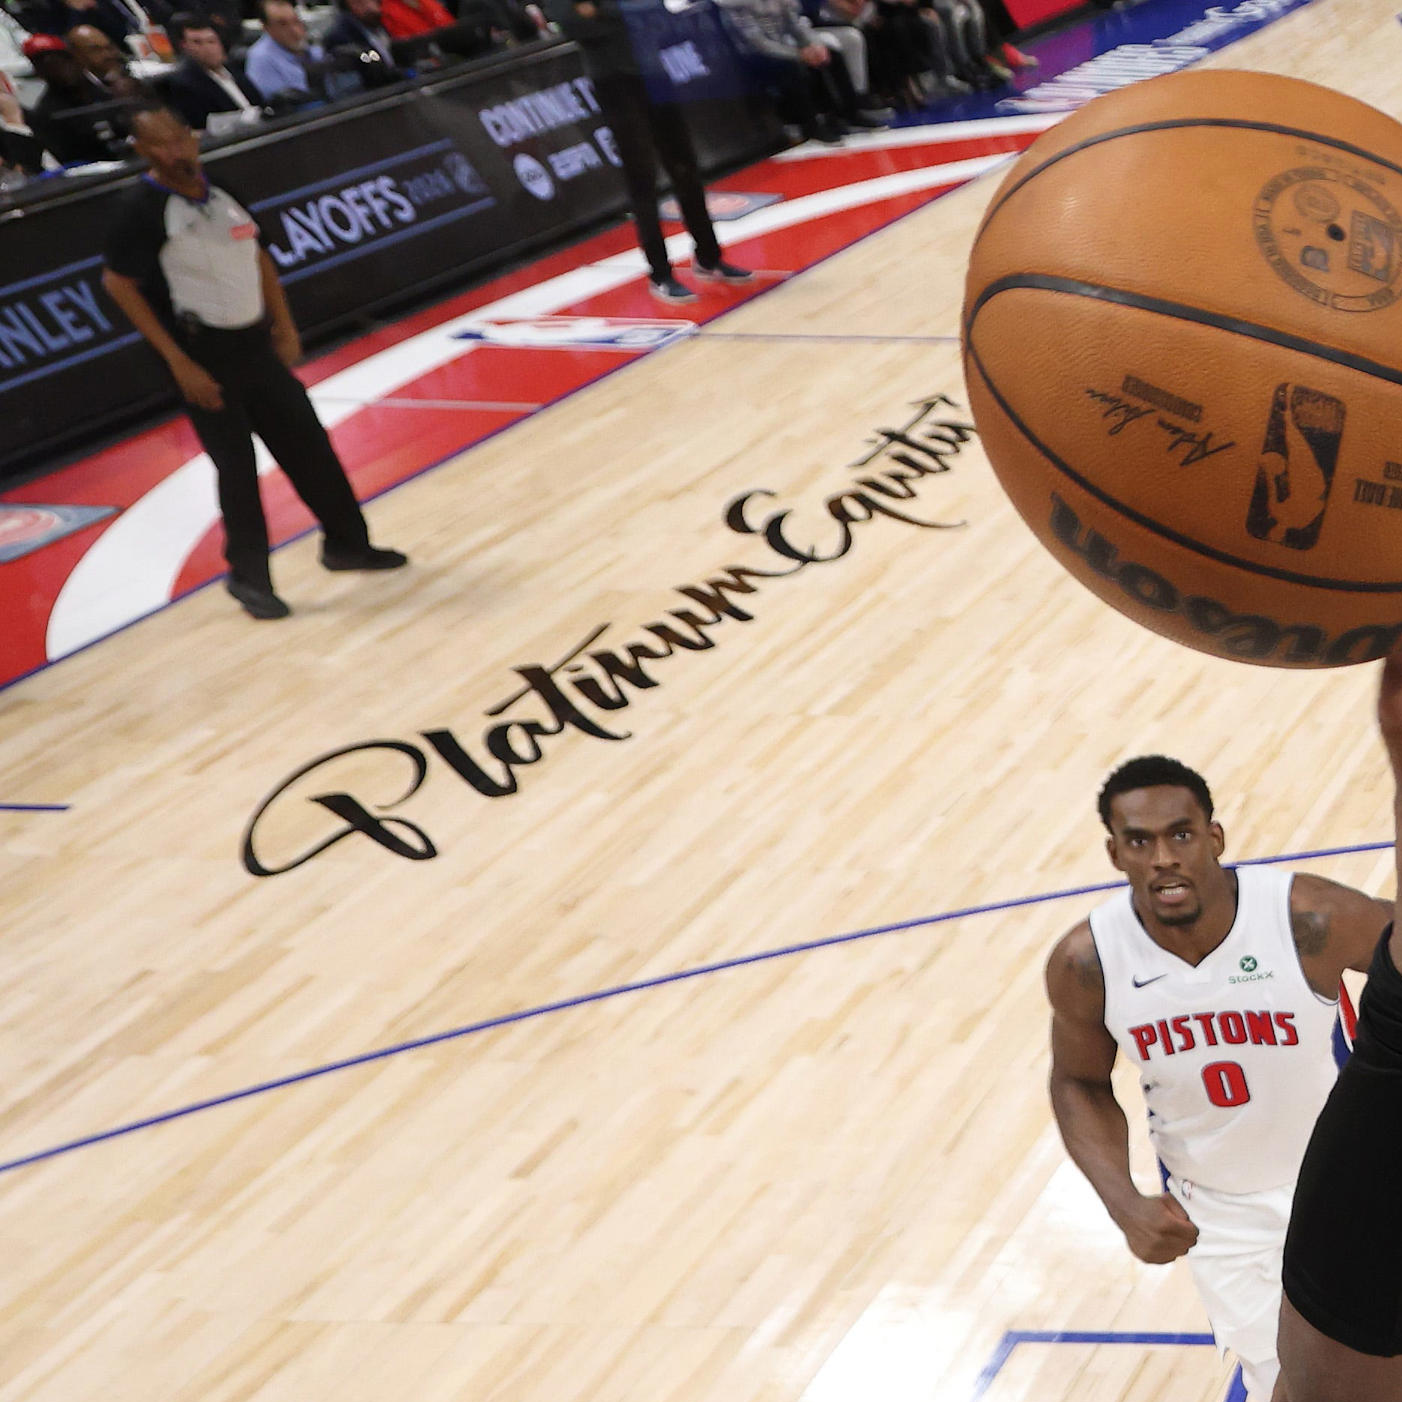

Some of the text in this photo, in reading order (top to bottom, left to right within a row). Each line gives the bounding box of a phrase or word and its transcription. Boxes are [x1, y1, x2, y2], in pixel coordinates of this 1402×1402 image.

[268, 176, 417, 267] LAYOFFS
[0, 280, 112, 368] NLEY
[241, 563, 760, 877] Platinum
[1128, 1010, 1299, 1061] PISTONS
[1201, 1060, 1251, 1108] 0
